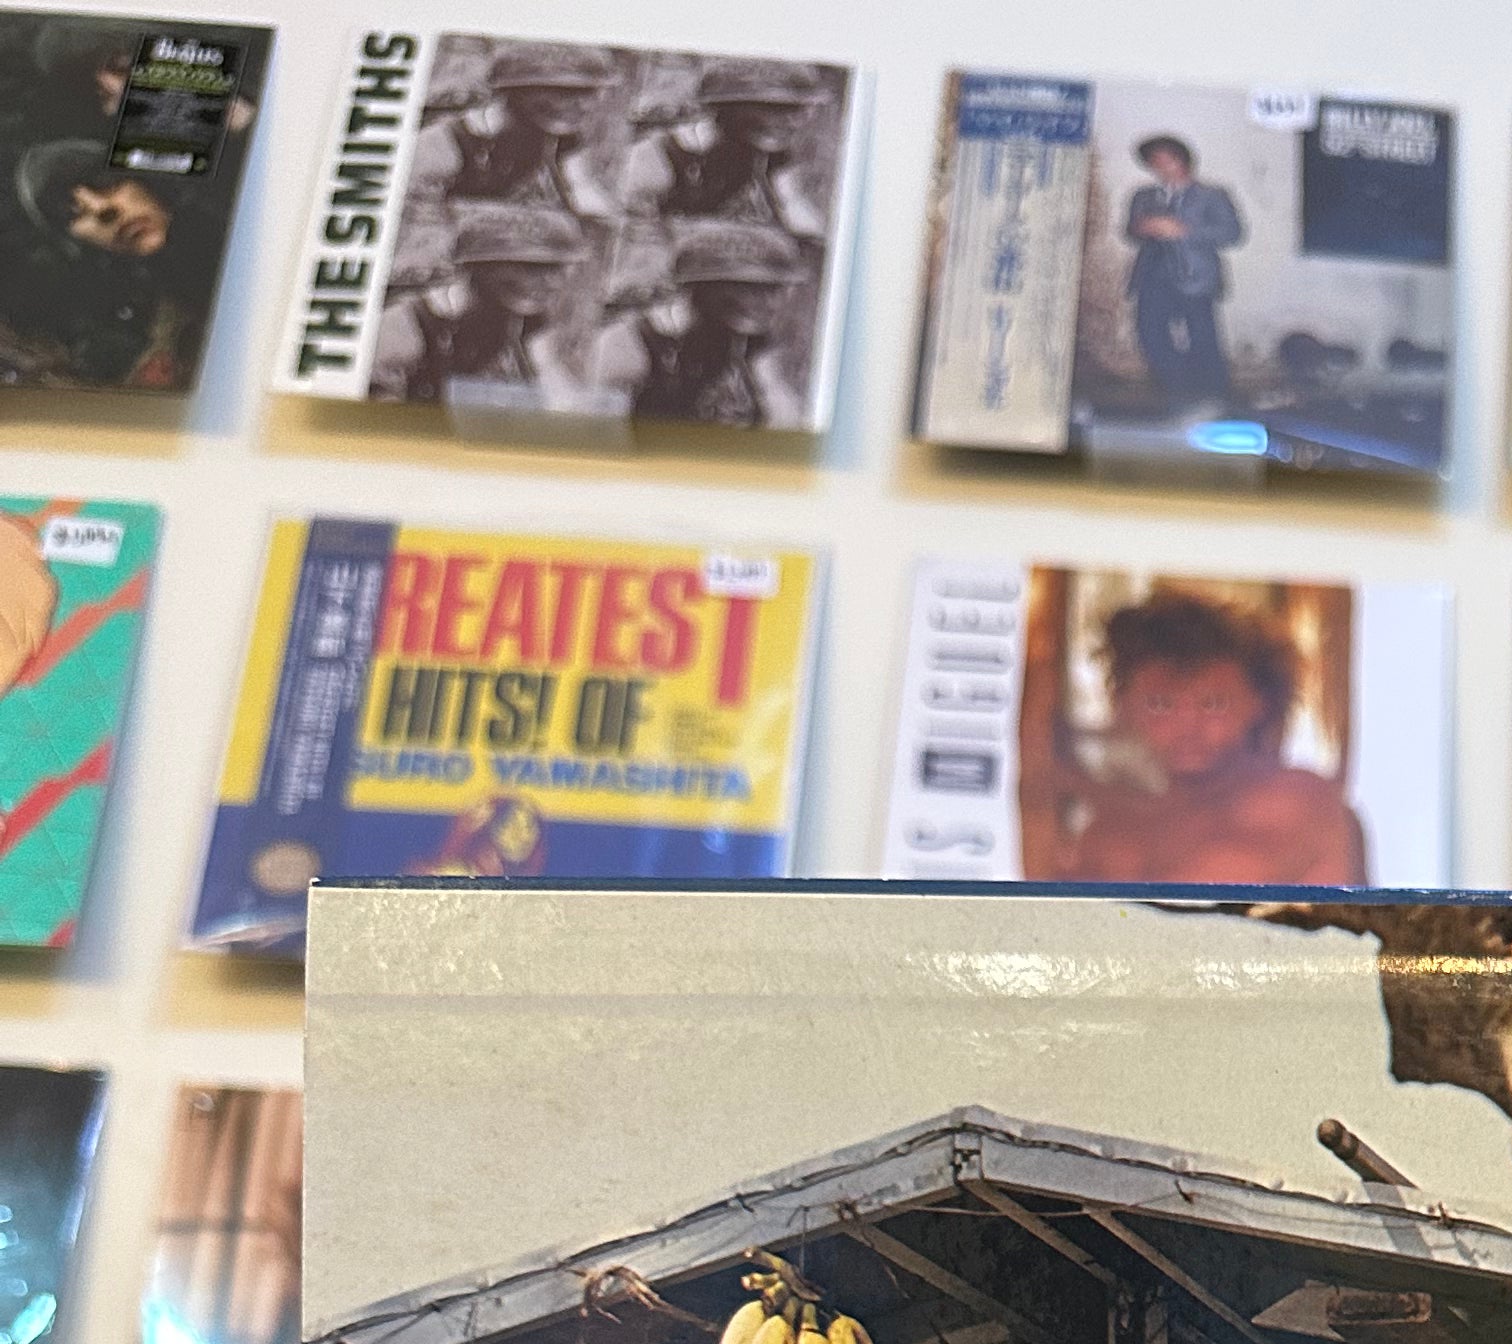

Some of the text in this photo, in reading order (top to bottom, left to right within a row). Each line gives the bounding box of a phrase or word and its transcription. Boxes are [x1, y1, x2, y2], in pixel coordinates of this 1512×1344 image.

[295, 31, 420, 382] THE SMITHS
[381, 666, 657, 757] HITS! OF
